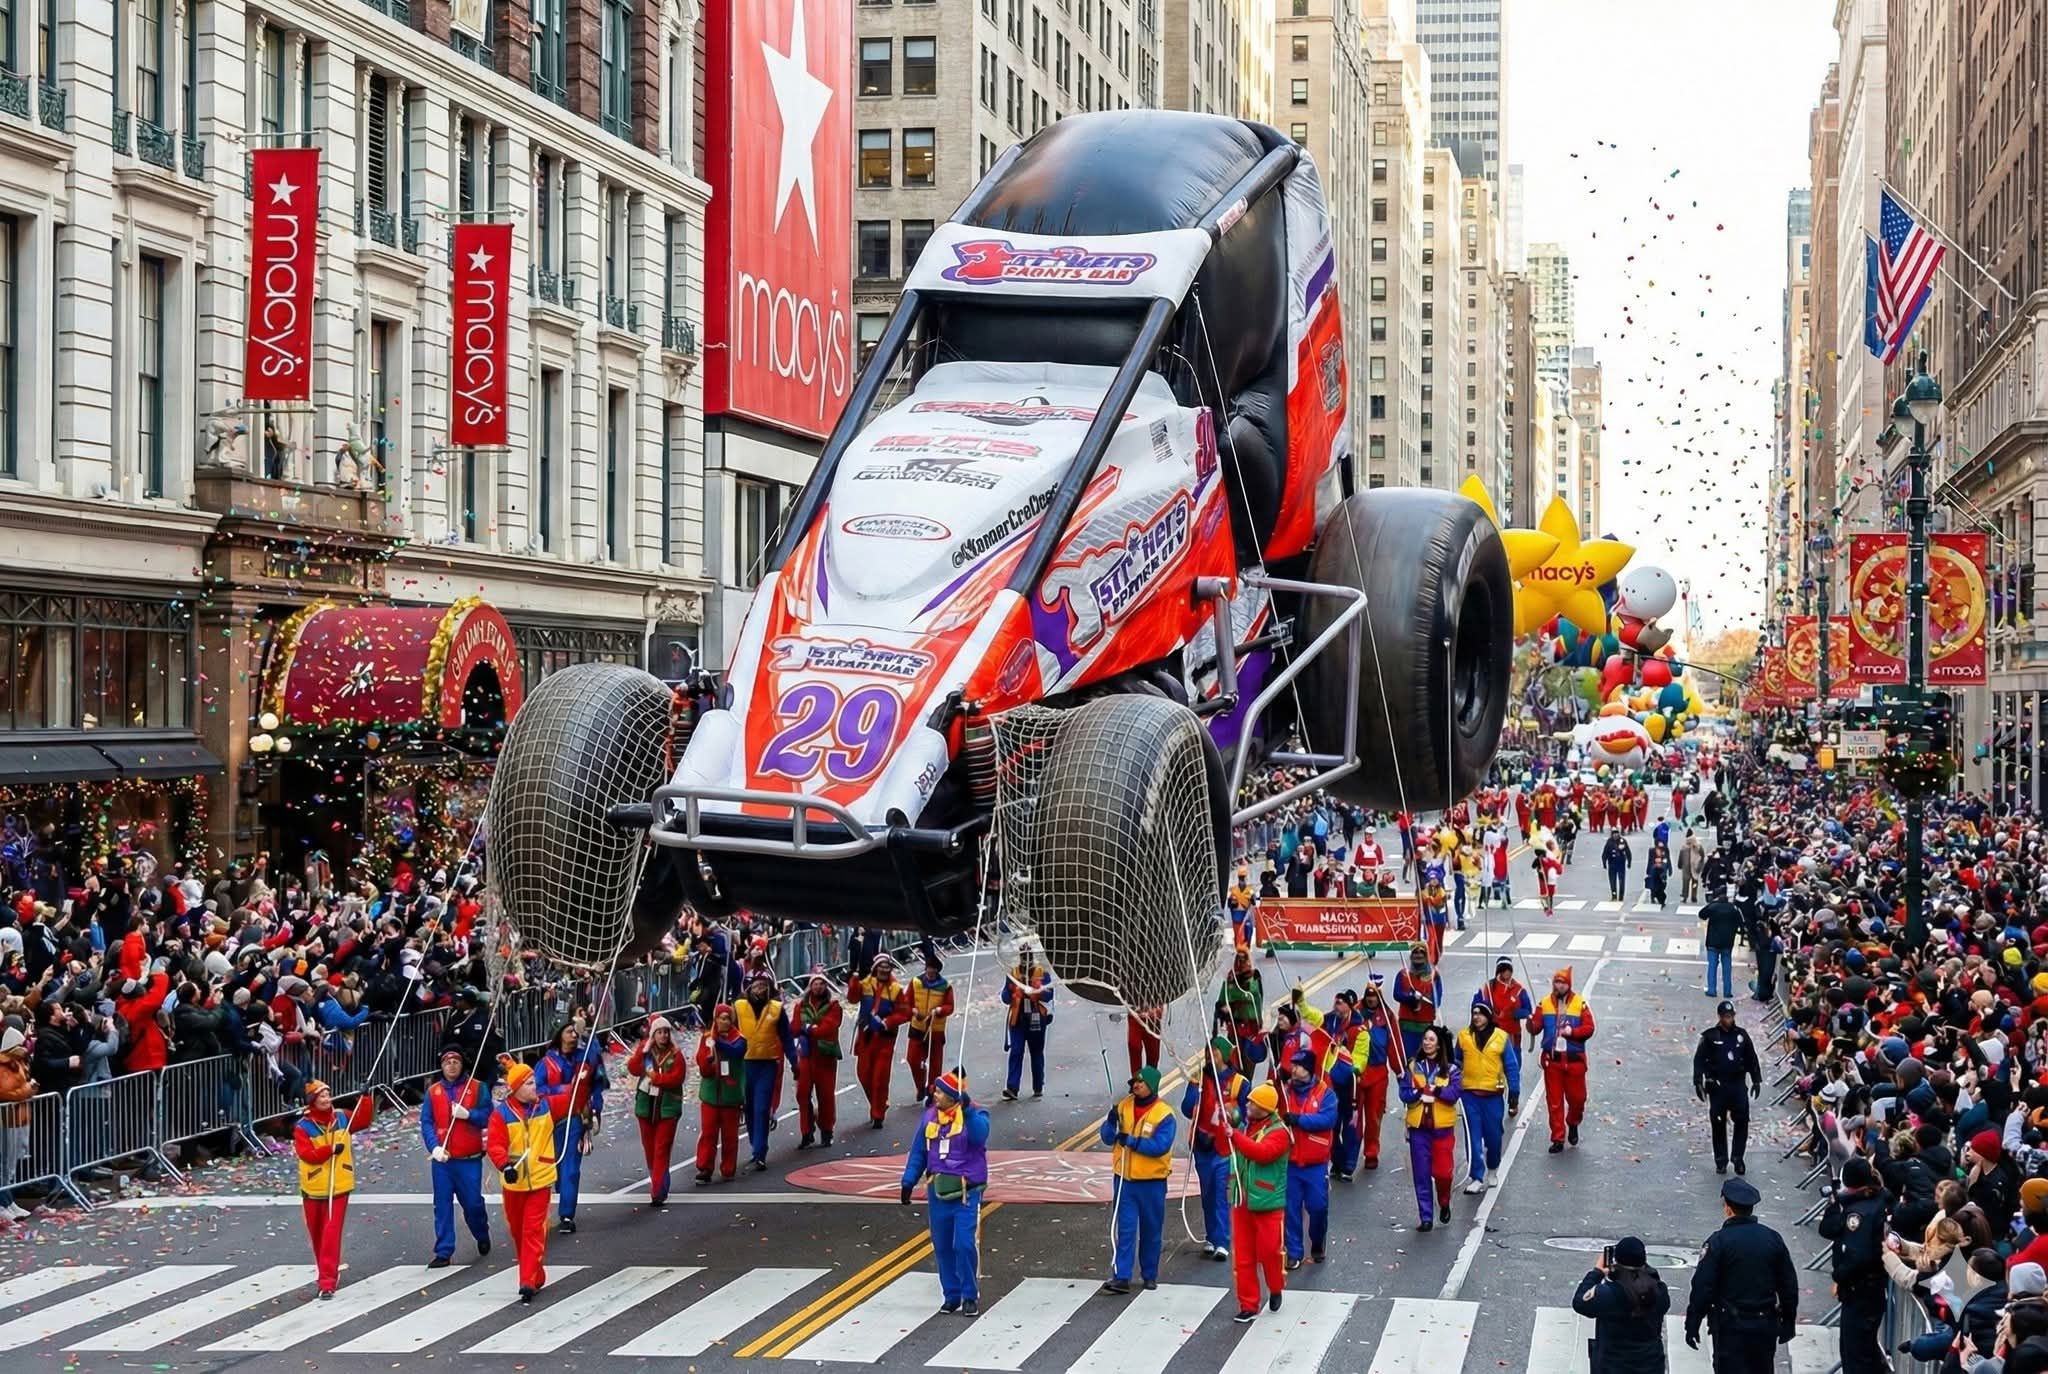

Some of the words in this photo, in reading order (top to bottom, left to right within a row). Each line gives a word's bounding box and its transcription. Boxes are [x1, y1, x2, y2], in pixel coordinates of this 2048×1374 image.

[251, 214, 303, 377] macy's
[456, 280, 501, 425] macy's
[738, 270, 845, 421] macy's
[755, 682, 901, 783] 29
[1364, 924, 1384, 934] DAY
